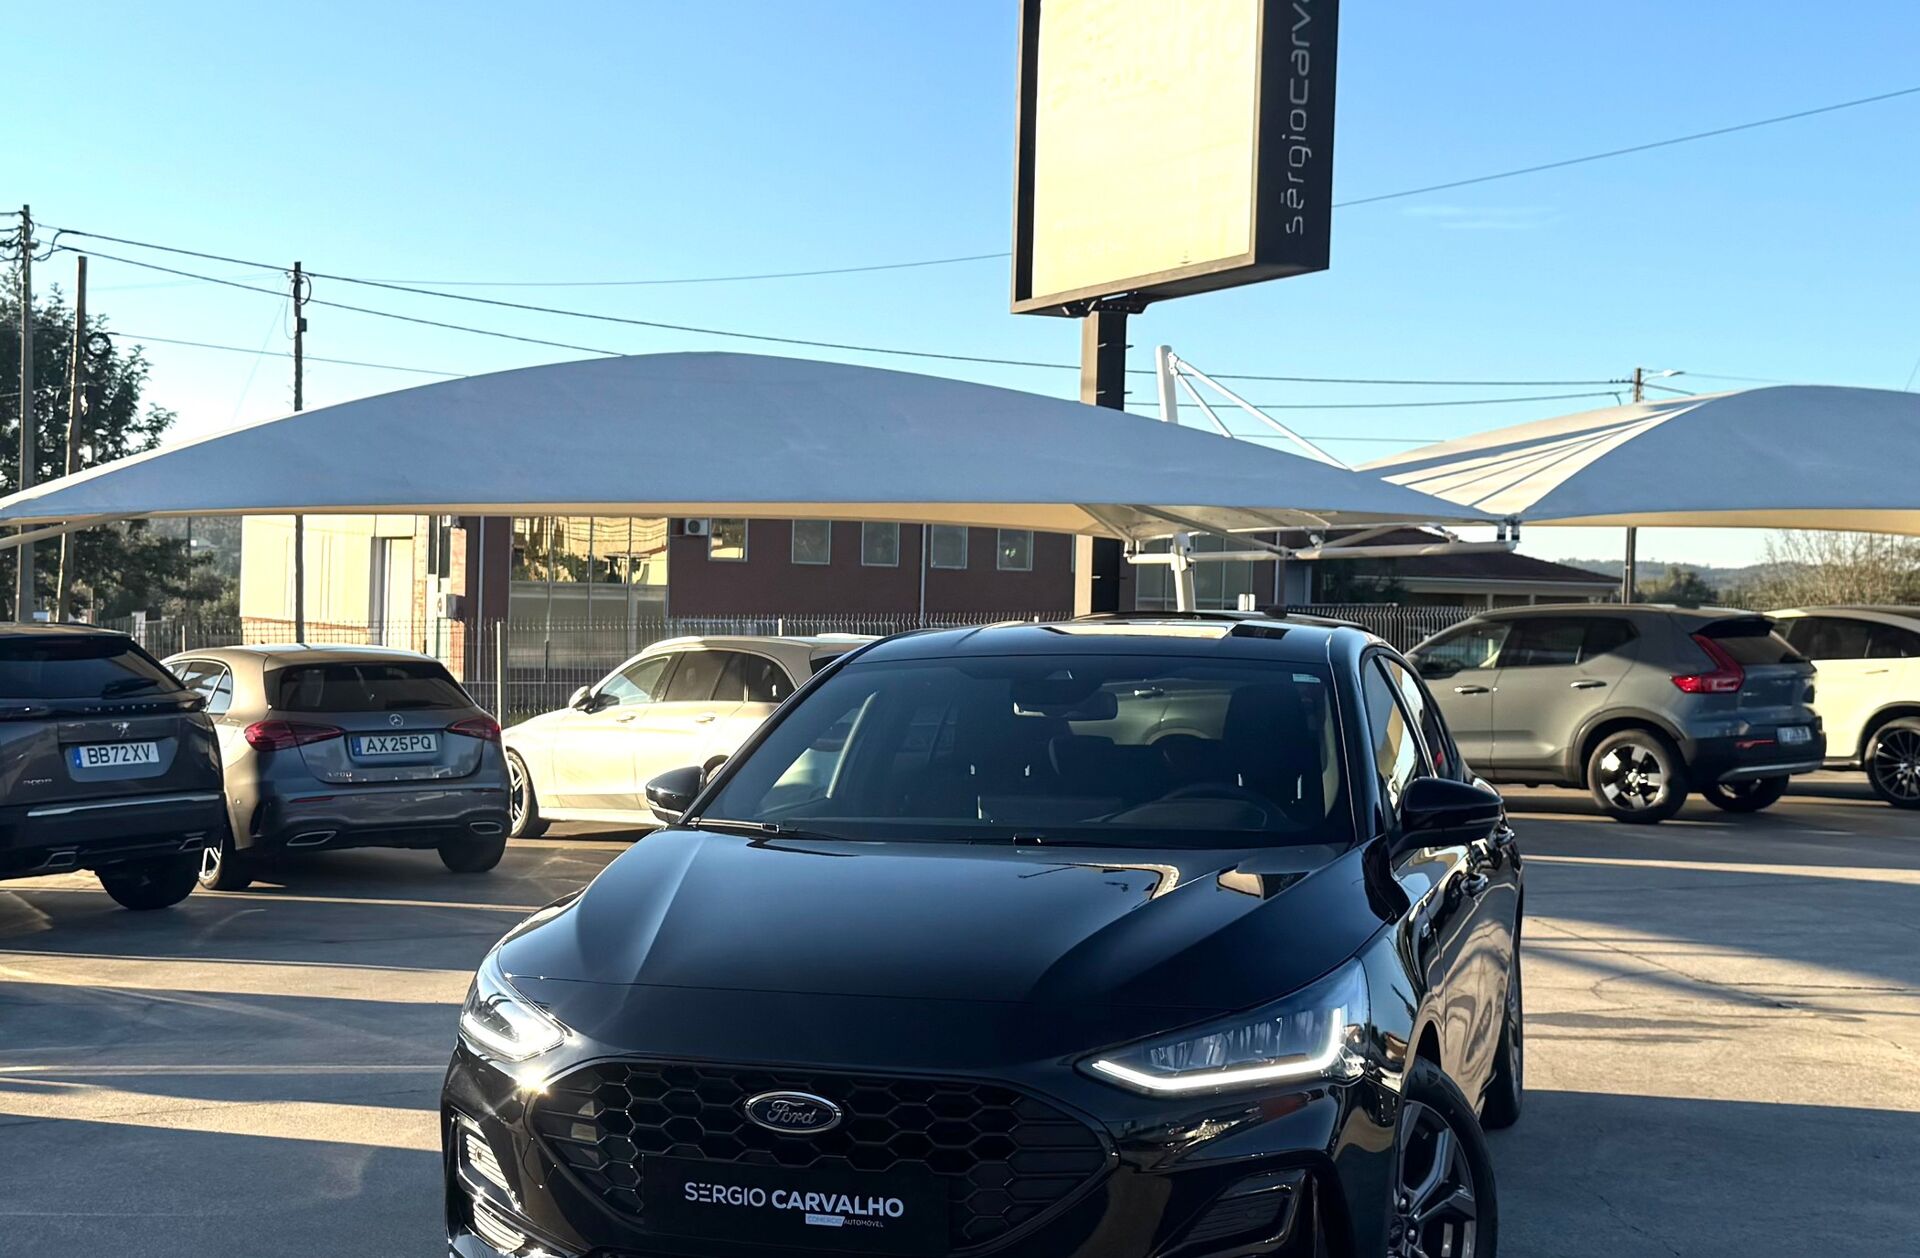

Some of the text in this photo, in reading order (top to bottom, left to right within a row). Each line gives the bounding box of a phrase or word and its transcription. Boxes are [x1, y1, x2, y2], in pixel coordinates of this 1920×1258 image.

[86, 743, 151, 765] BB72XV
[366, 735, 432, 753] AX25PQ
[766, 1099, 818, 1125] Ford
[771, 1189, 905, 1218] CARVALHO
